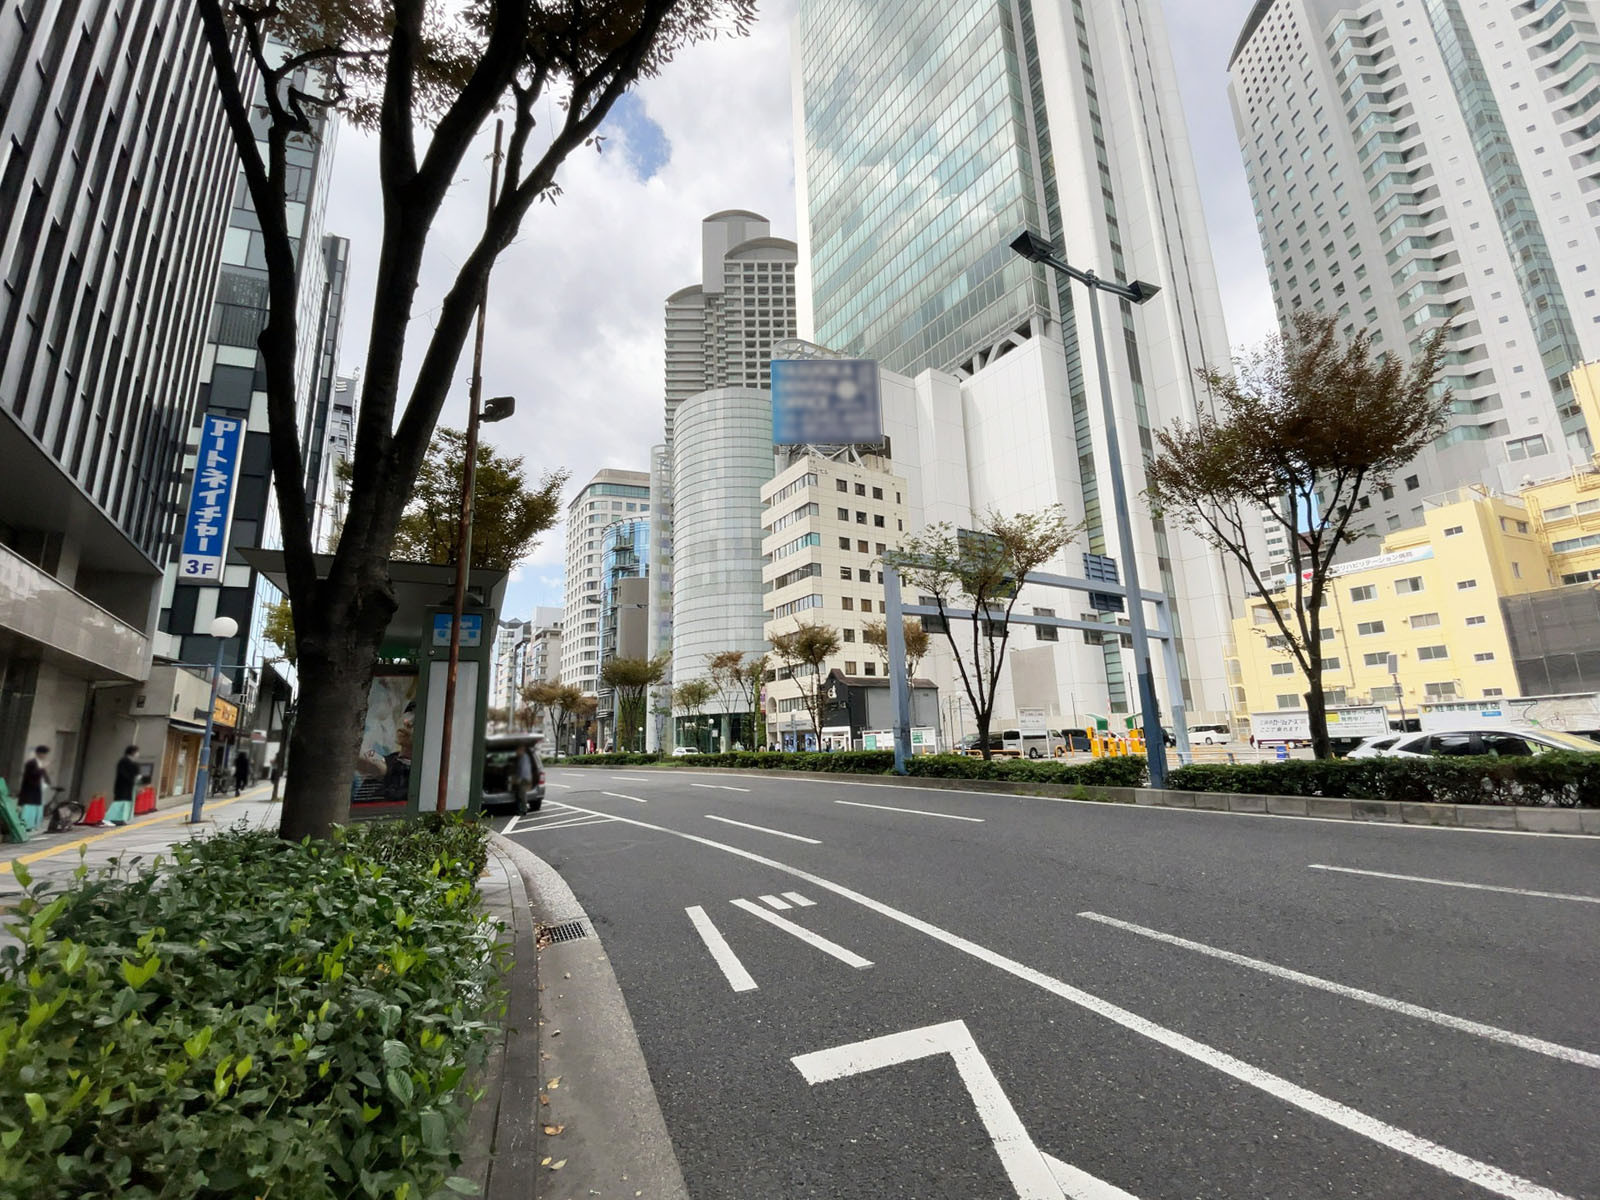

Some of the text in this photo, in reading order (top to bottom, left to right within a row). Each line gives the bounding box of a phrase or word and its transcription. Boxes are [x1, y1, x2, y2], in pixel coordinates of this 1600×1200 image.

[194, 418, 237, 552] アートネイチャー
[185, 559, 214, 575] 3F
